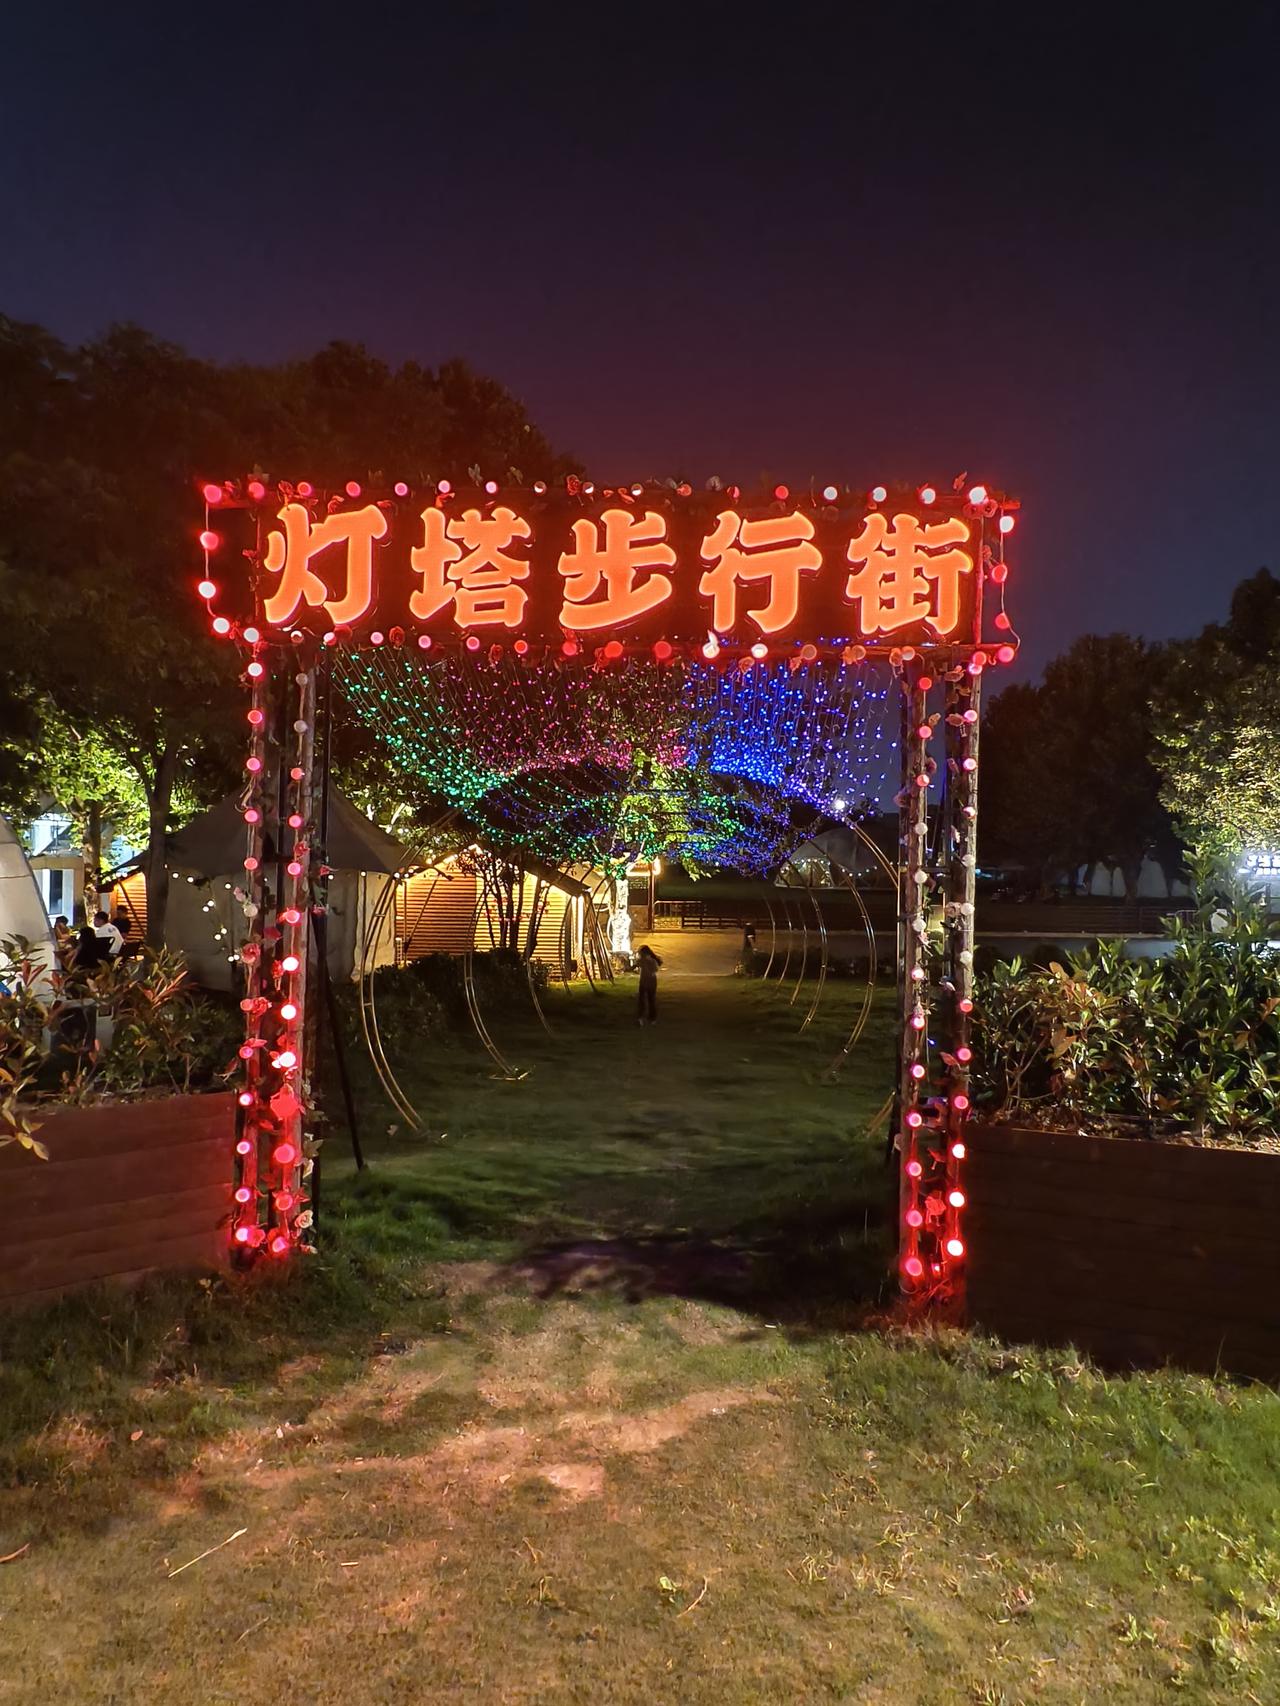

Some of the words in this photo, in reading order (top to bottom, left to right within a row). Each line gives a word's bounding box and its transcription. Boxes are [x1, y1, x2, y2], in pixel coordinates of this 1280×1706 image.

[263, 503, 974, 636] 灯塔步行街
